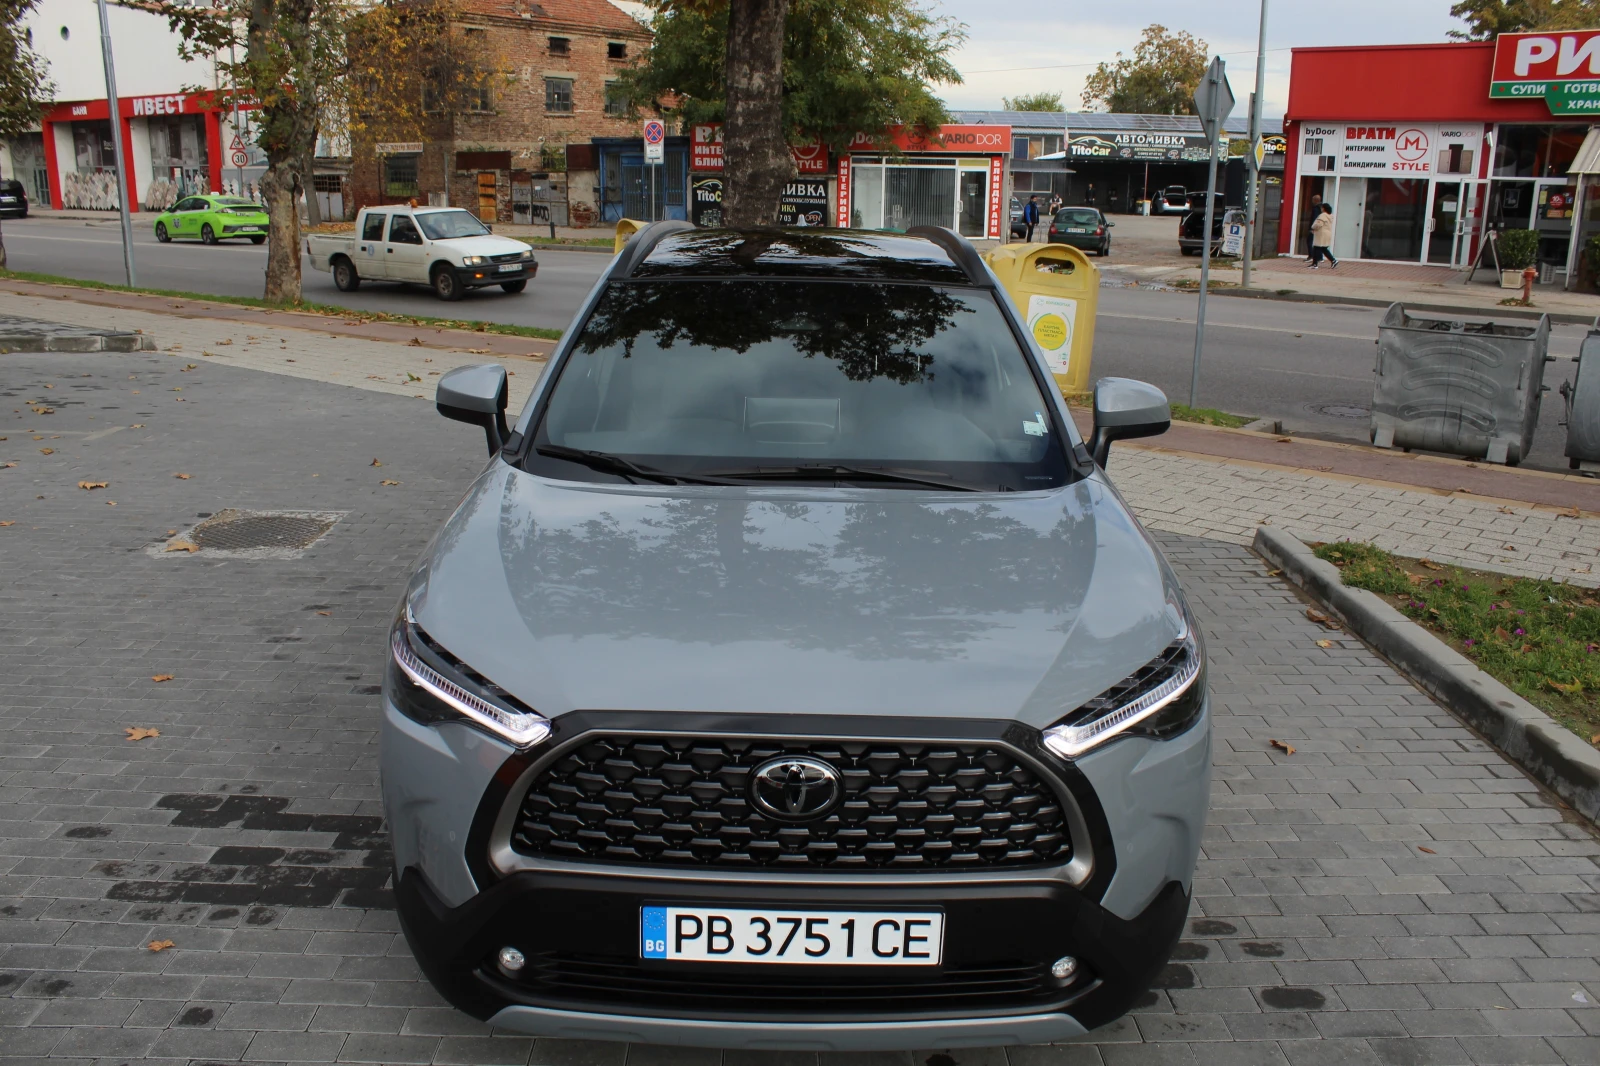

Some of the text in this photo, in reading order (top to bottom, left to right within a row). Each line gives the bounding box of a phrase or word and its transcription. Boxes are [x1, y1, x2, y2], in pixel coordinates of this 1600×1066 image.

[1511, 84, 1547, 94] СУПИ
[1564, 83, 1600, 94] ГОТВ
[133, 95, 187, 116] ИВЕСТ
[1305, 127, 1336, 136] byDoor
[1346, 127, 1396, 140] ВРАТИ
[1115, 134, 1186, 145] АВТОМИВКА
[695, 146, 723, 154] ИНТЕ
[1071, 145, 1111, 156] TitoCar
[235, 154, 245, 164] 30
[797, 160, 823, 169] TYLE
[1344, 161, 1386, 169] БЛИНДИРАНИ
[1392, 163, 1430, 171] STYLE
[991, 160, 1001, 234] БЛИНДИРАНИ
[675, 914, 932, 958] PB 3751 CE
[645, 939, 665, 952] BG
